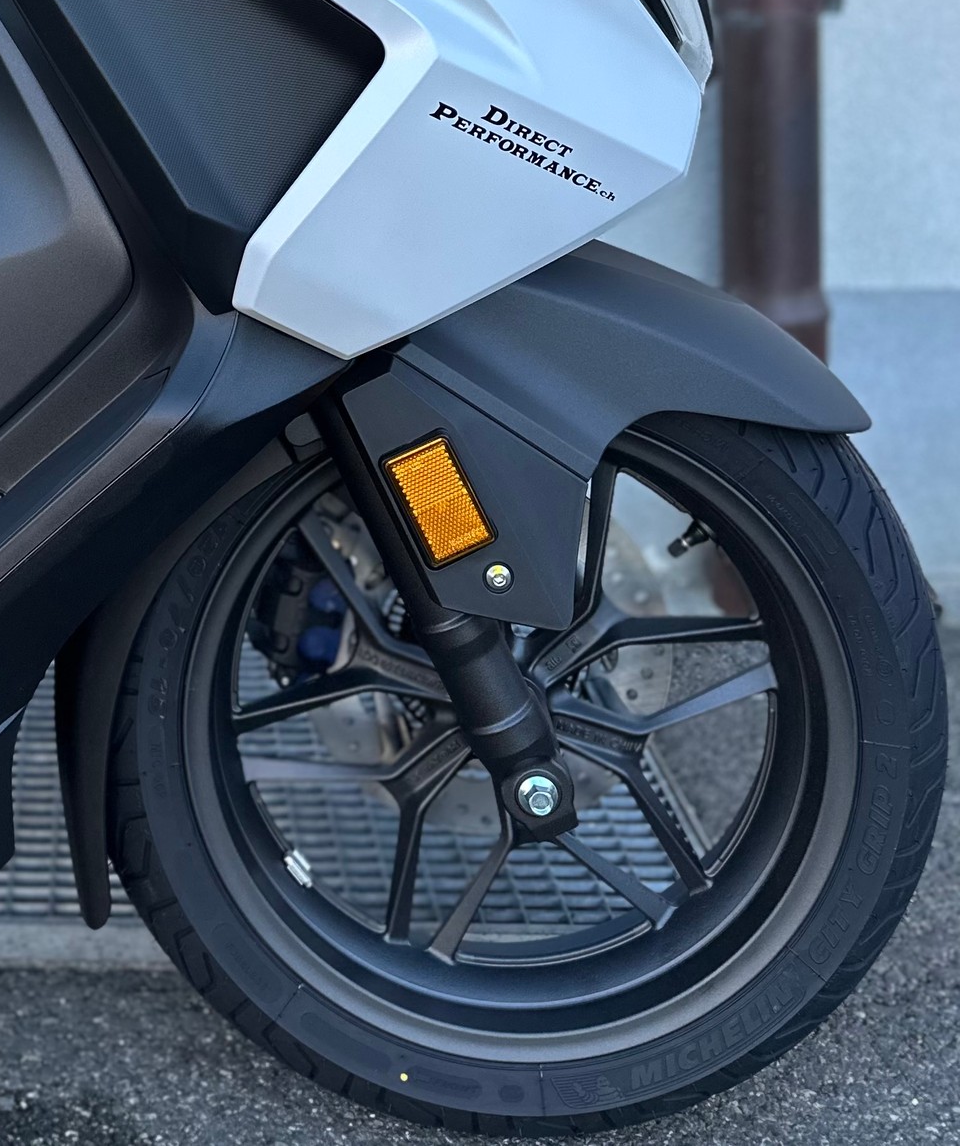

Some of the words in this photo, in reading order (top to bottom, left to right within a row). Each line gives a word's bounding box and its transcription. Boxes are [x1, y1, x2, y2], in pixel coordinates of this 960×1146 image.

[856, 784, 892, 876] GRIP
[876, 752, 897, 779] 2
[631, 968, 797, 1090] MICHELIN
